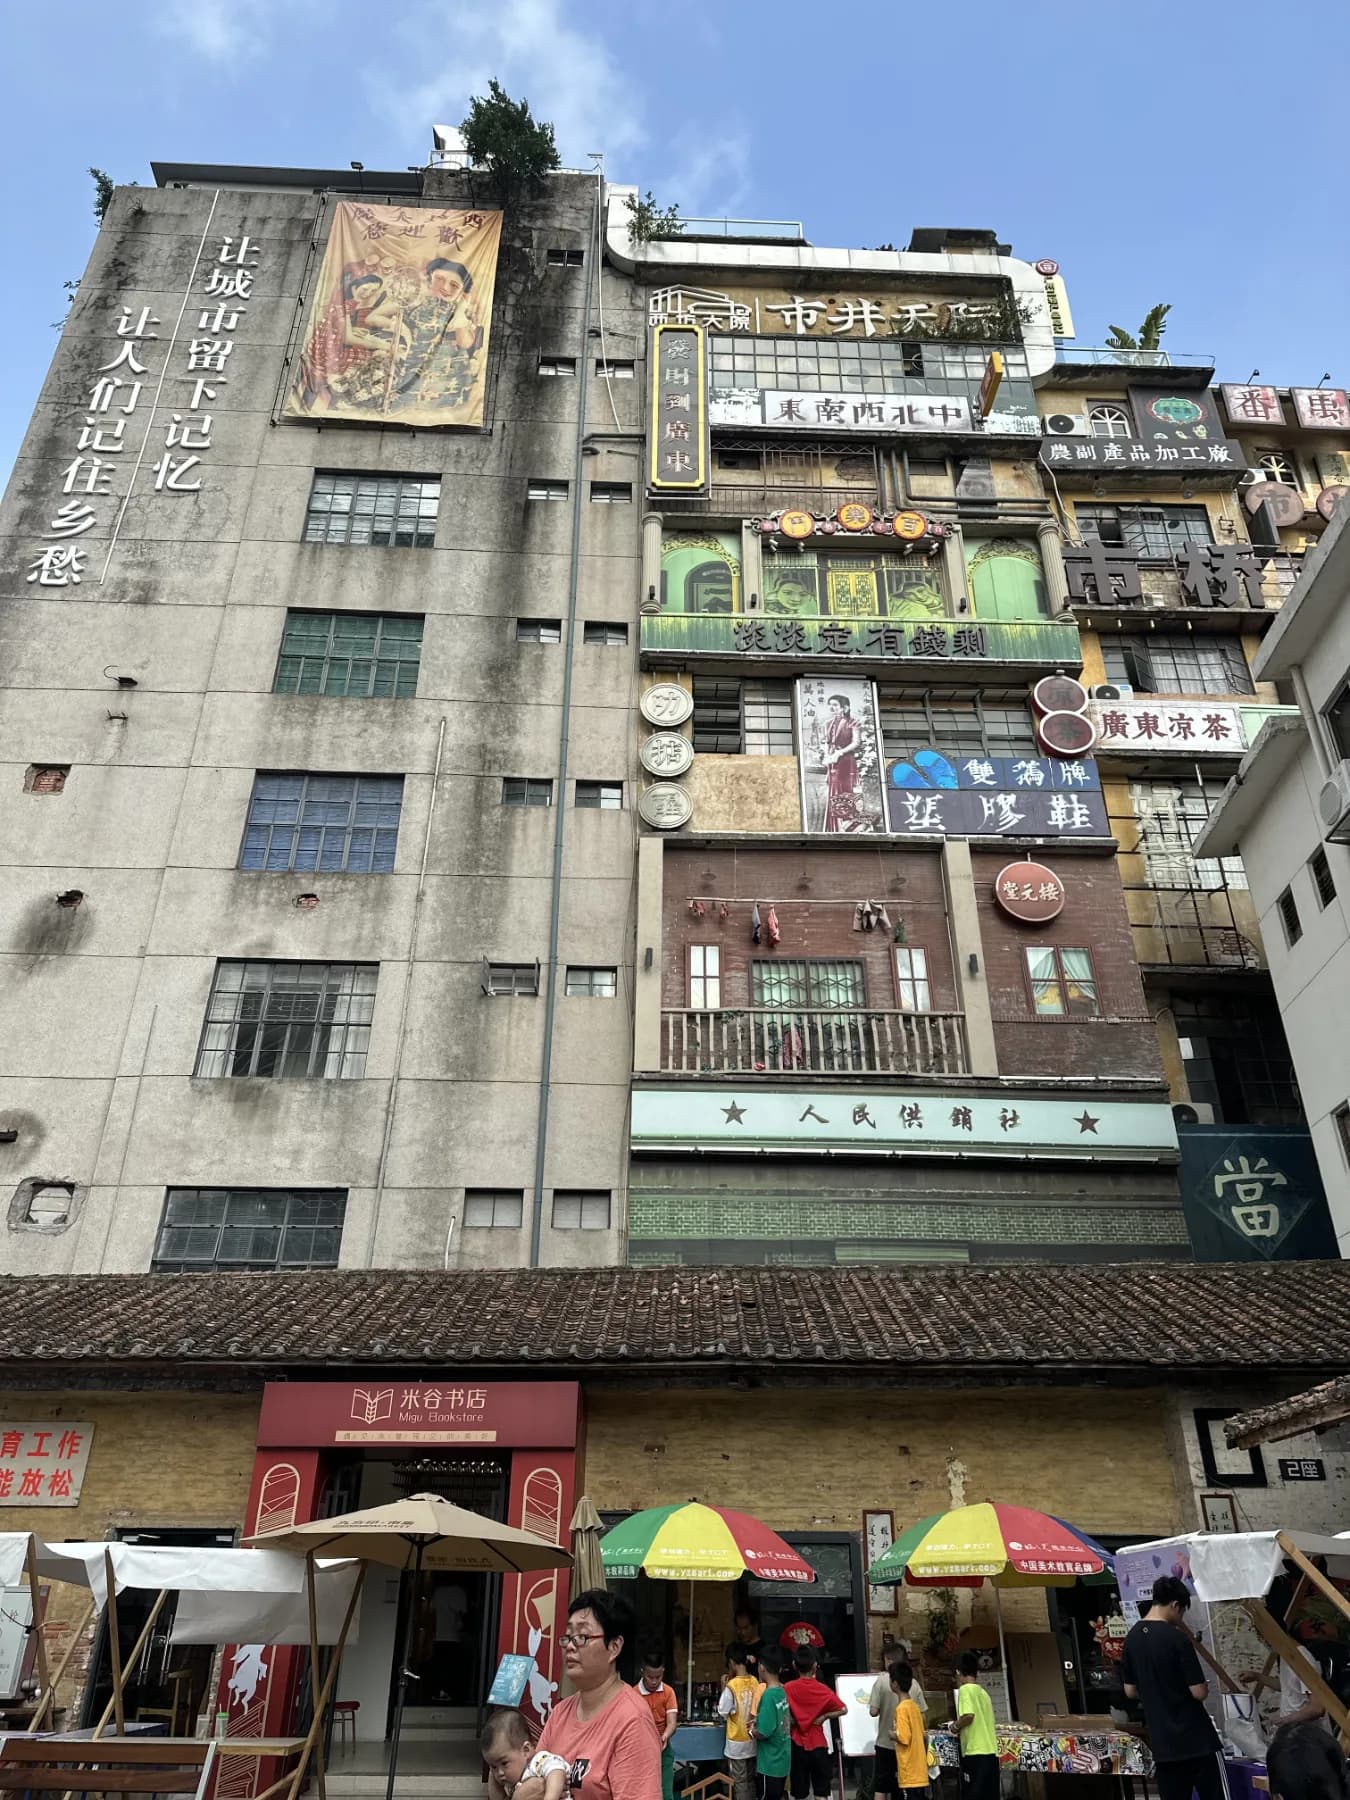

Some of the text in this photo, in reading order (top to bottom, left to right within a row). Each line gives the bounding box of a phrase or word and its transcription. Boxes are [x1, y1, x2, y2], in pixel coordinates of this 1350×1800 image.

[152, 236, 261, 492] 让城市留下记忆
[661, 337, 696, 473] 發財到廣東
[773, 397, 963, 427] 東南西北中
[27, 306, 161, 587] 让人们记住乡愁
[1062, 539, 1268, 609] 市桥
[799, 1103, 1021, 1132] 人民供銷社
[400, 1388, 488, 1410] 米谷书店
[400, 1411, 484, 1424] Migu Bookstore
[0, 1430, 84, 1460] 育工作
